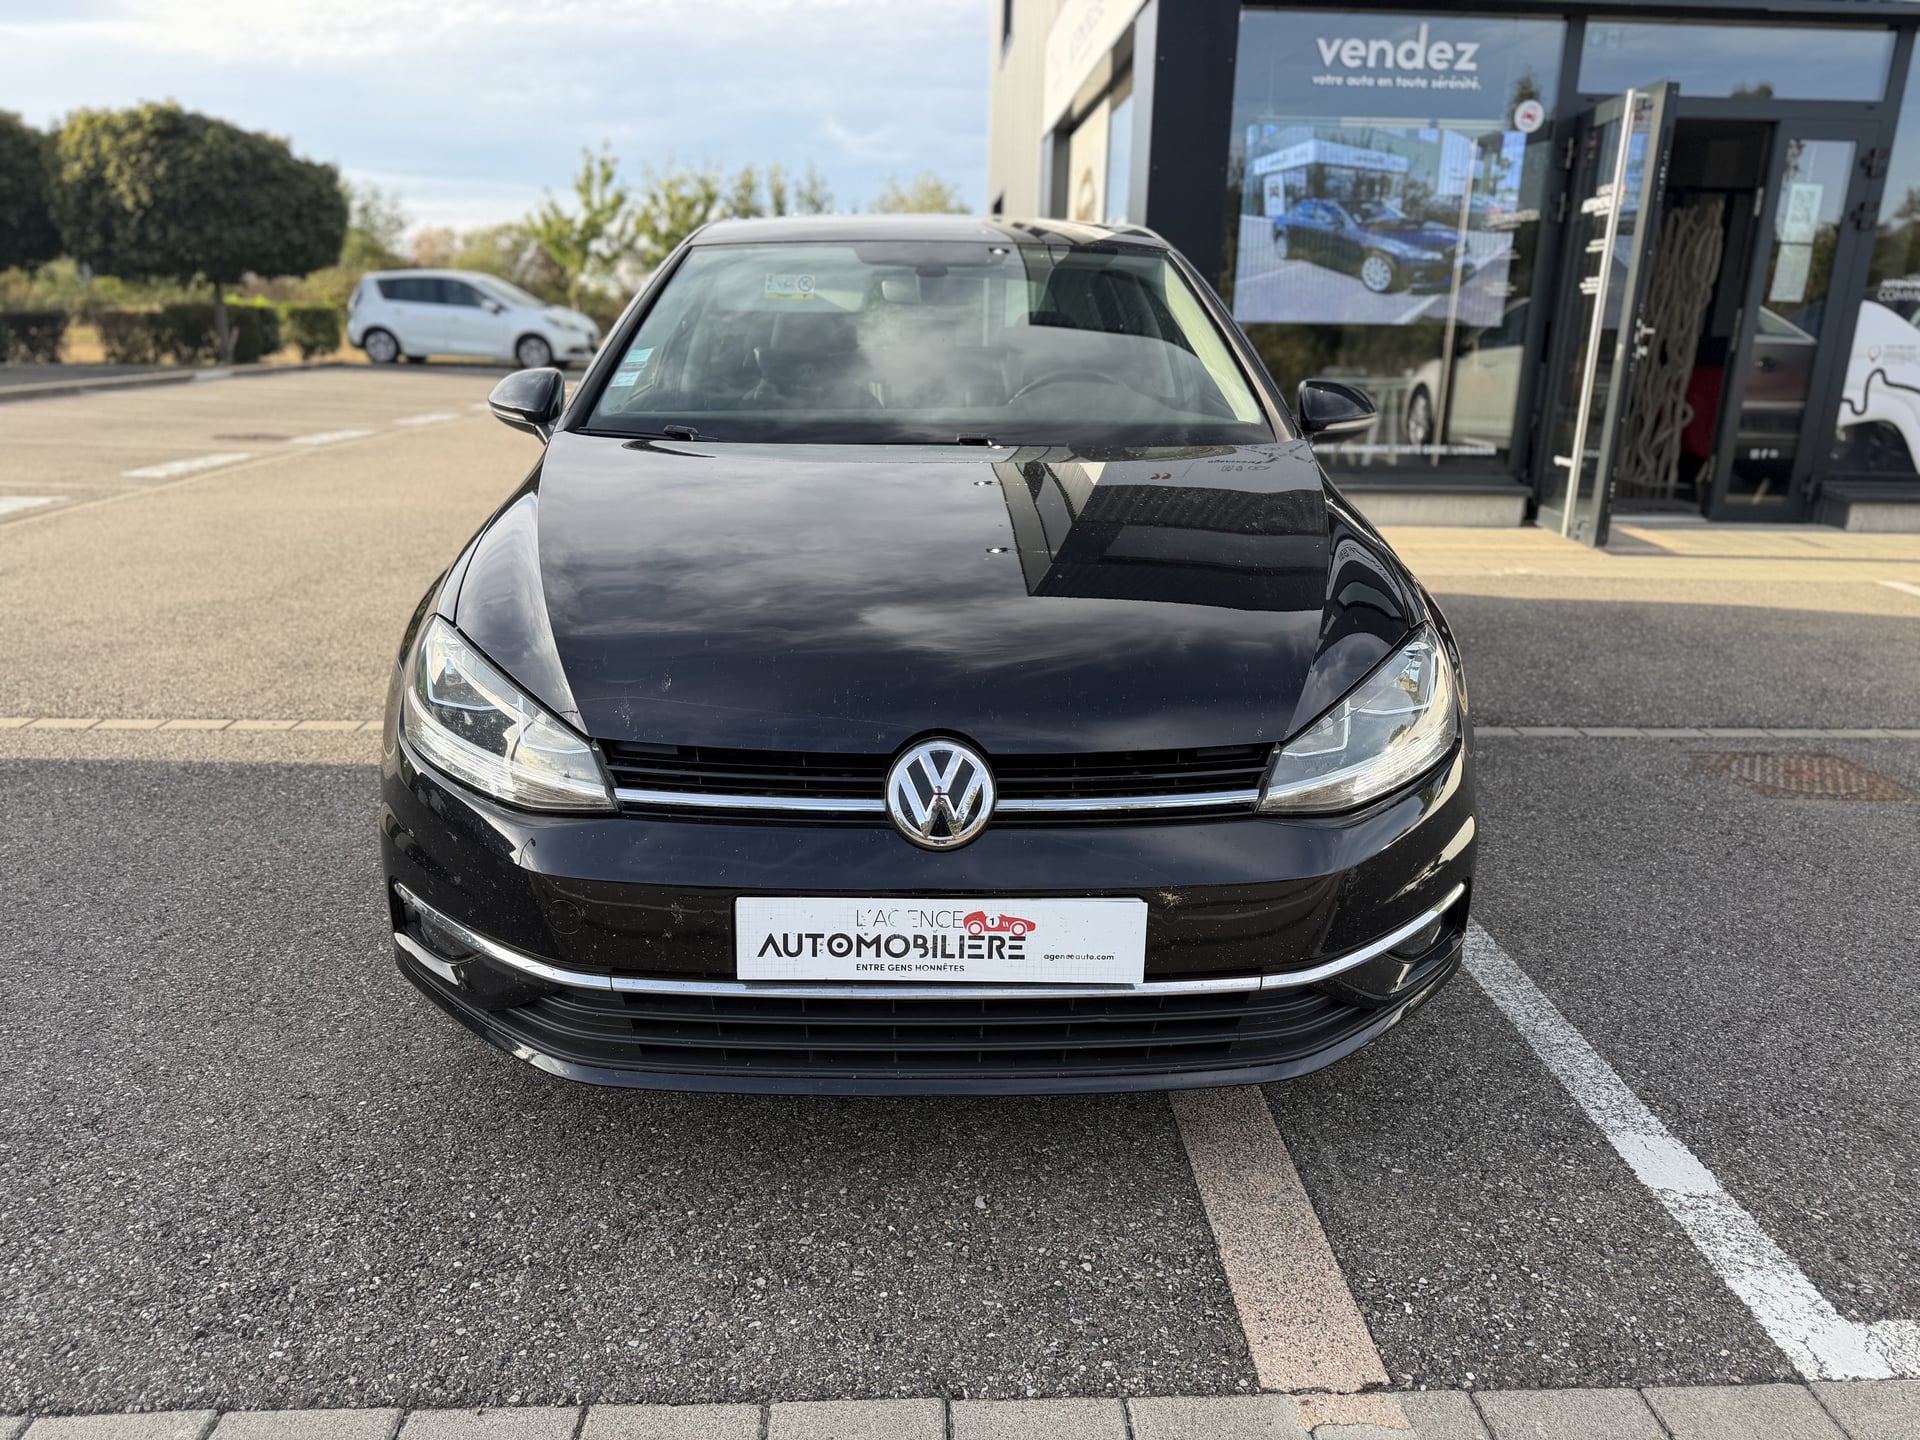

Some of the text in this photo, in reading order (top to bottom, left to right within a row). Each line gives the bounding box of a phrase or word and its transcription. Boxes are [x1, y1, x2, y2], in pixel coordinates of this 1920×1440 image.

[1316, 22, 1481, 71] vendez
[1312, 75, 1344, 87] votre
[1346, 76, 1375, 88] auto
[1377, 77, 1393, 88] en
[1395, 76, 1428, 89] toute
[856, 962, 965, 973] ENTRE GENS HONNÊTES
